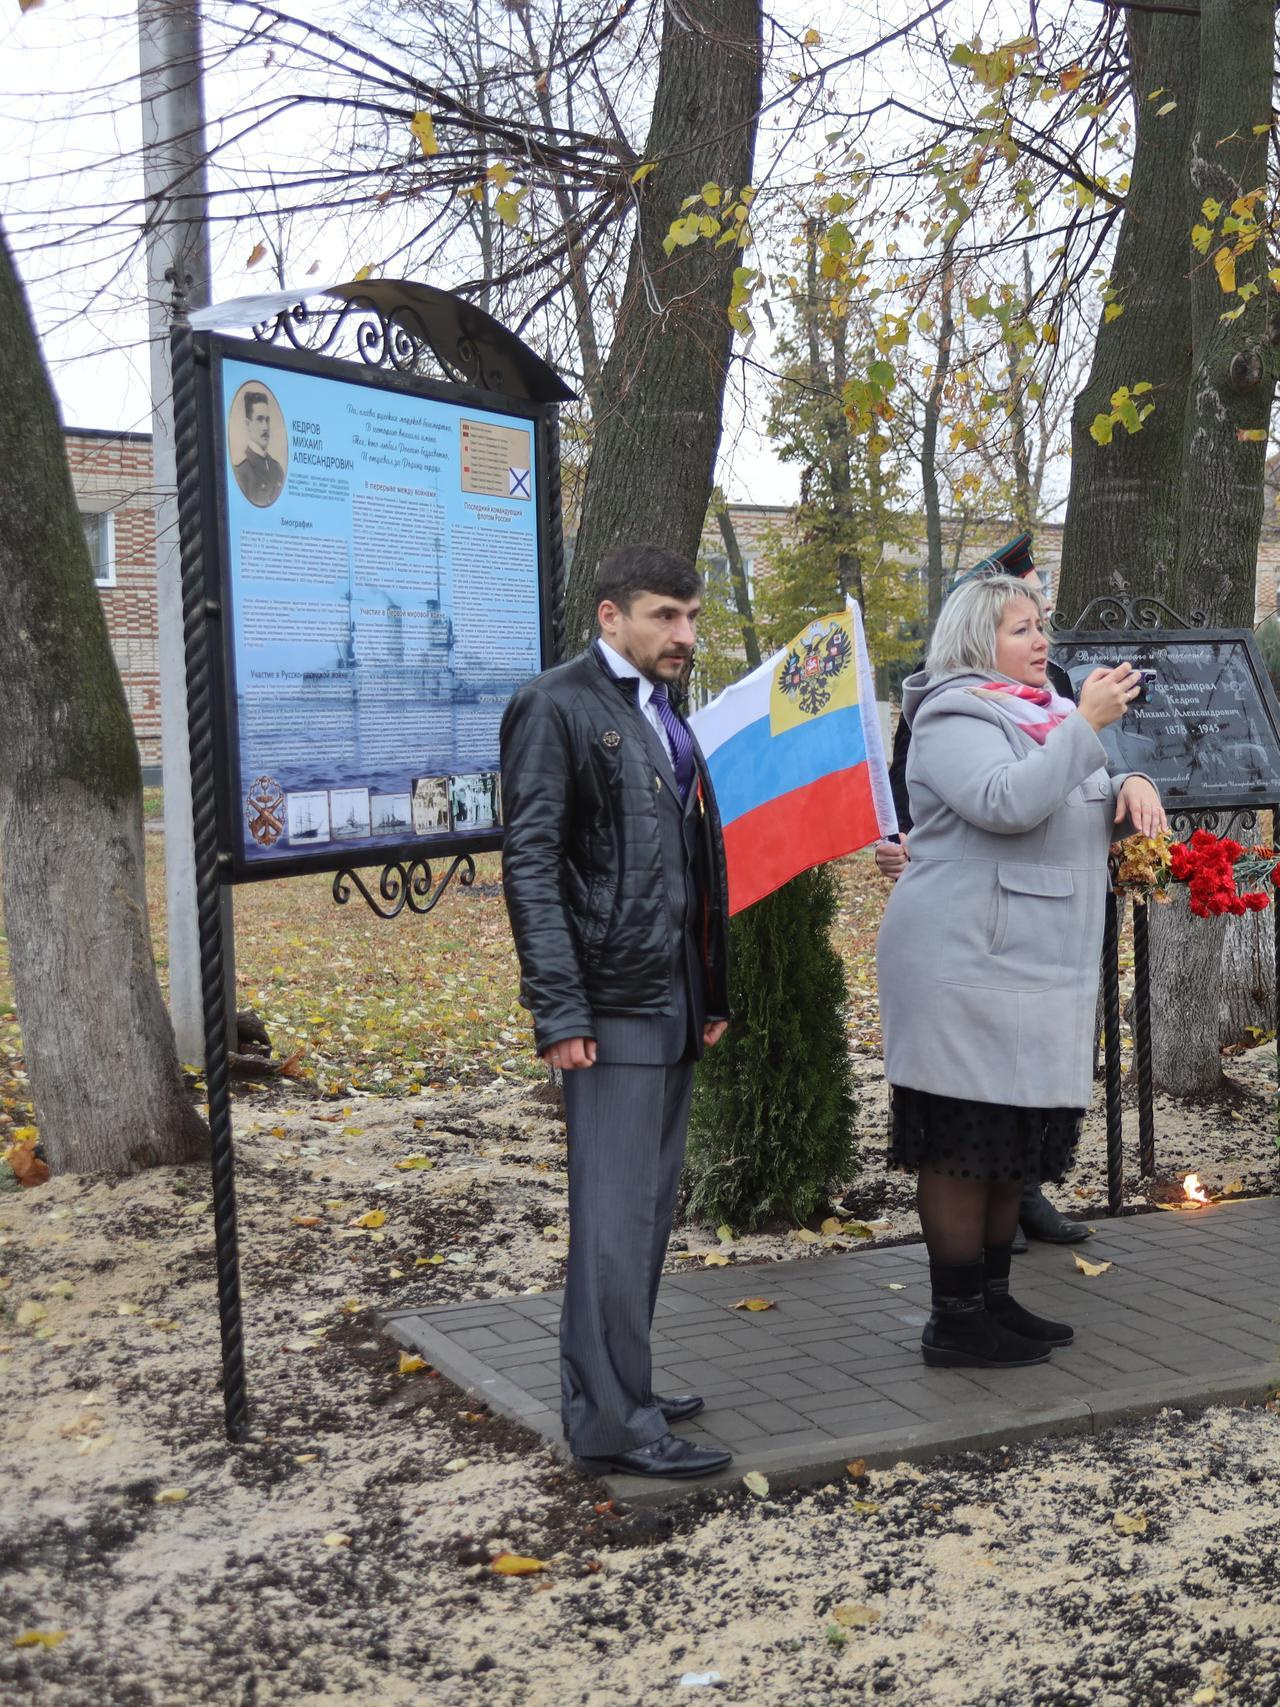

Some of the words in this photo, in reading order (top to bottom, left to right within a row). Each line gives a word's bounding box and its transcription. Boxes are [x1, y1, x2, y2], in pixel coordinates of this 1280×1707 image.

[292, 421, 320, 435] КЕДРОВ
[293, 436, 323, 450] МИХАИЛ
[293, 453, 354, 470] АЛЕКСАНДРОВИЧ
[369, 482, 396, 493] перерыве
[397, 487, 413, 495] между
[414, 488, 437, 497] войнами
[464, 502, 491, 513] Последний
[491, 506, 523, 517] командующий
[281, 517, 313, 528] Биография
[477, 513, 495, 521] флотом
[494, 514, 512, 523] России
[360, 608, 381, 616] Участие
[386, 608, 407, 617] Первой
[407, 611, 430, 619] мировой
[251, 670, 275, 679] Участие
[1155, 682, 1217, 693] ице-адмирал
[1166, 695, 1200, 705] Кедров
[1134, 709, 1171, 719] Михаил
[1173, 708, 1240, 719] Александрович
[1165, 725, 1188, 735] 1878
[1198, 724, 1220, 734] 1945
